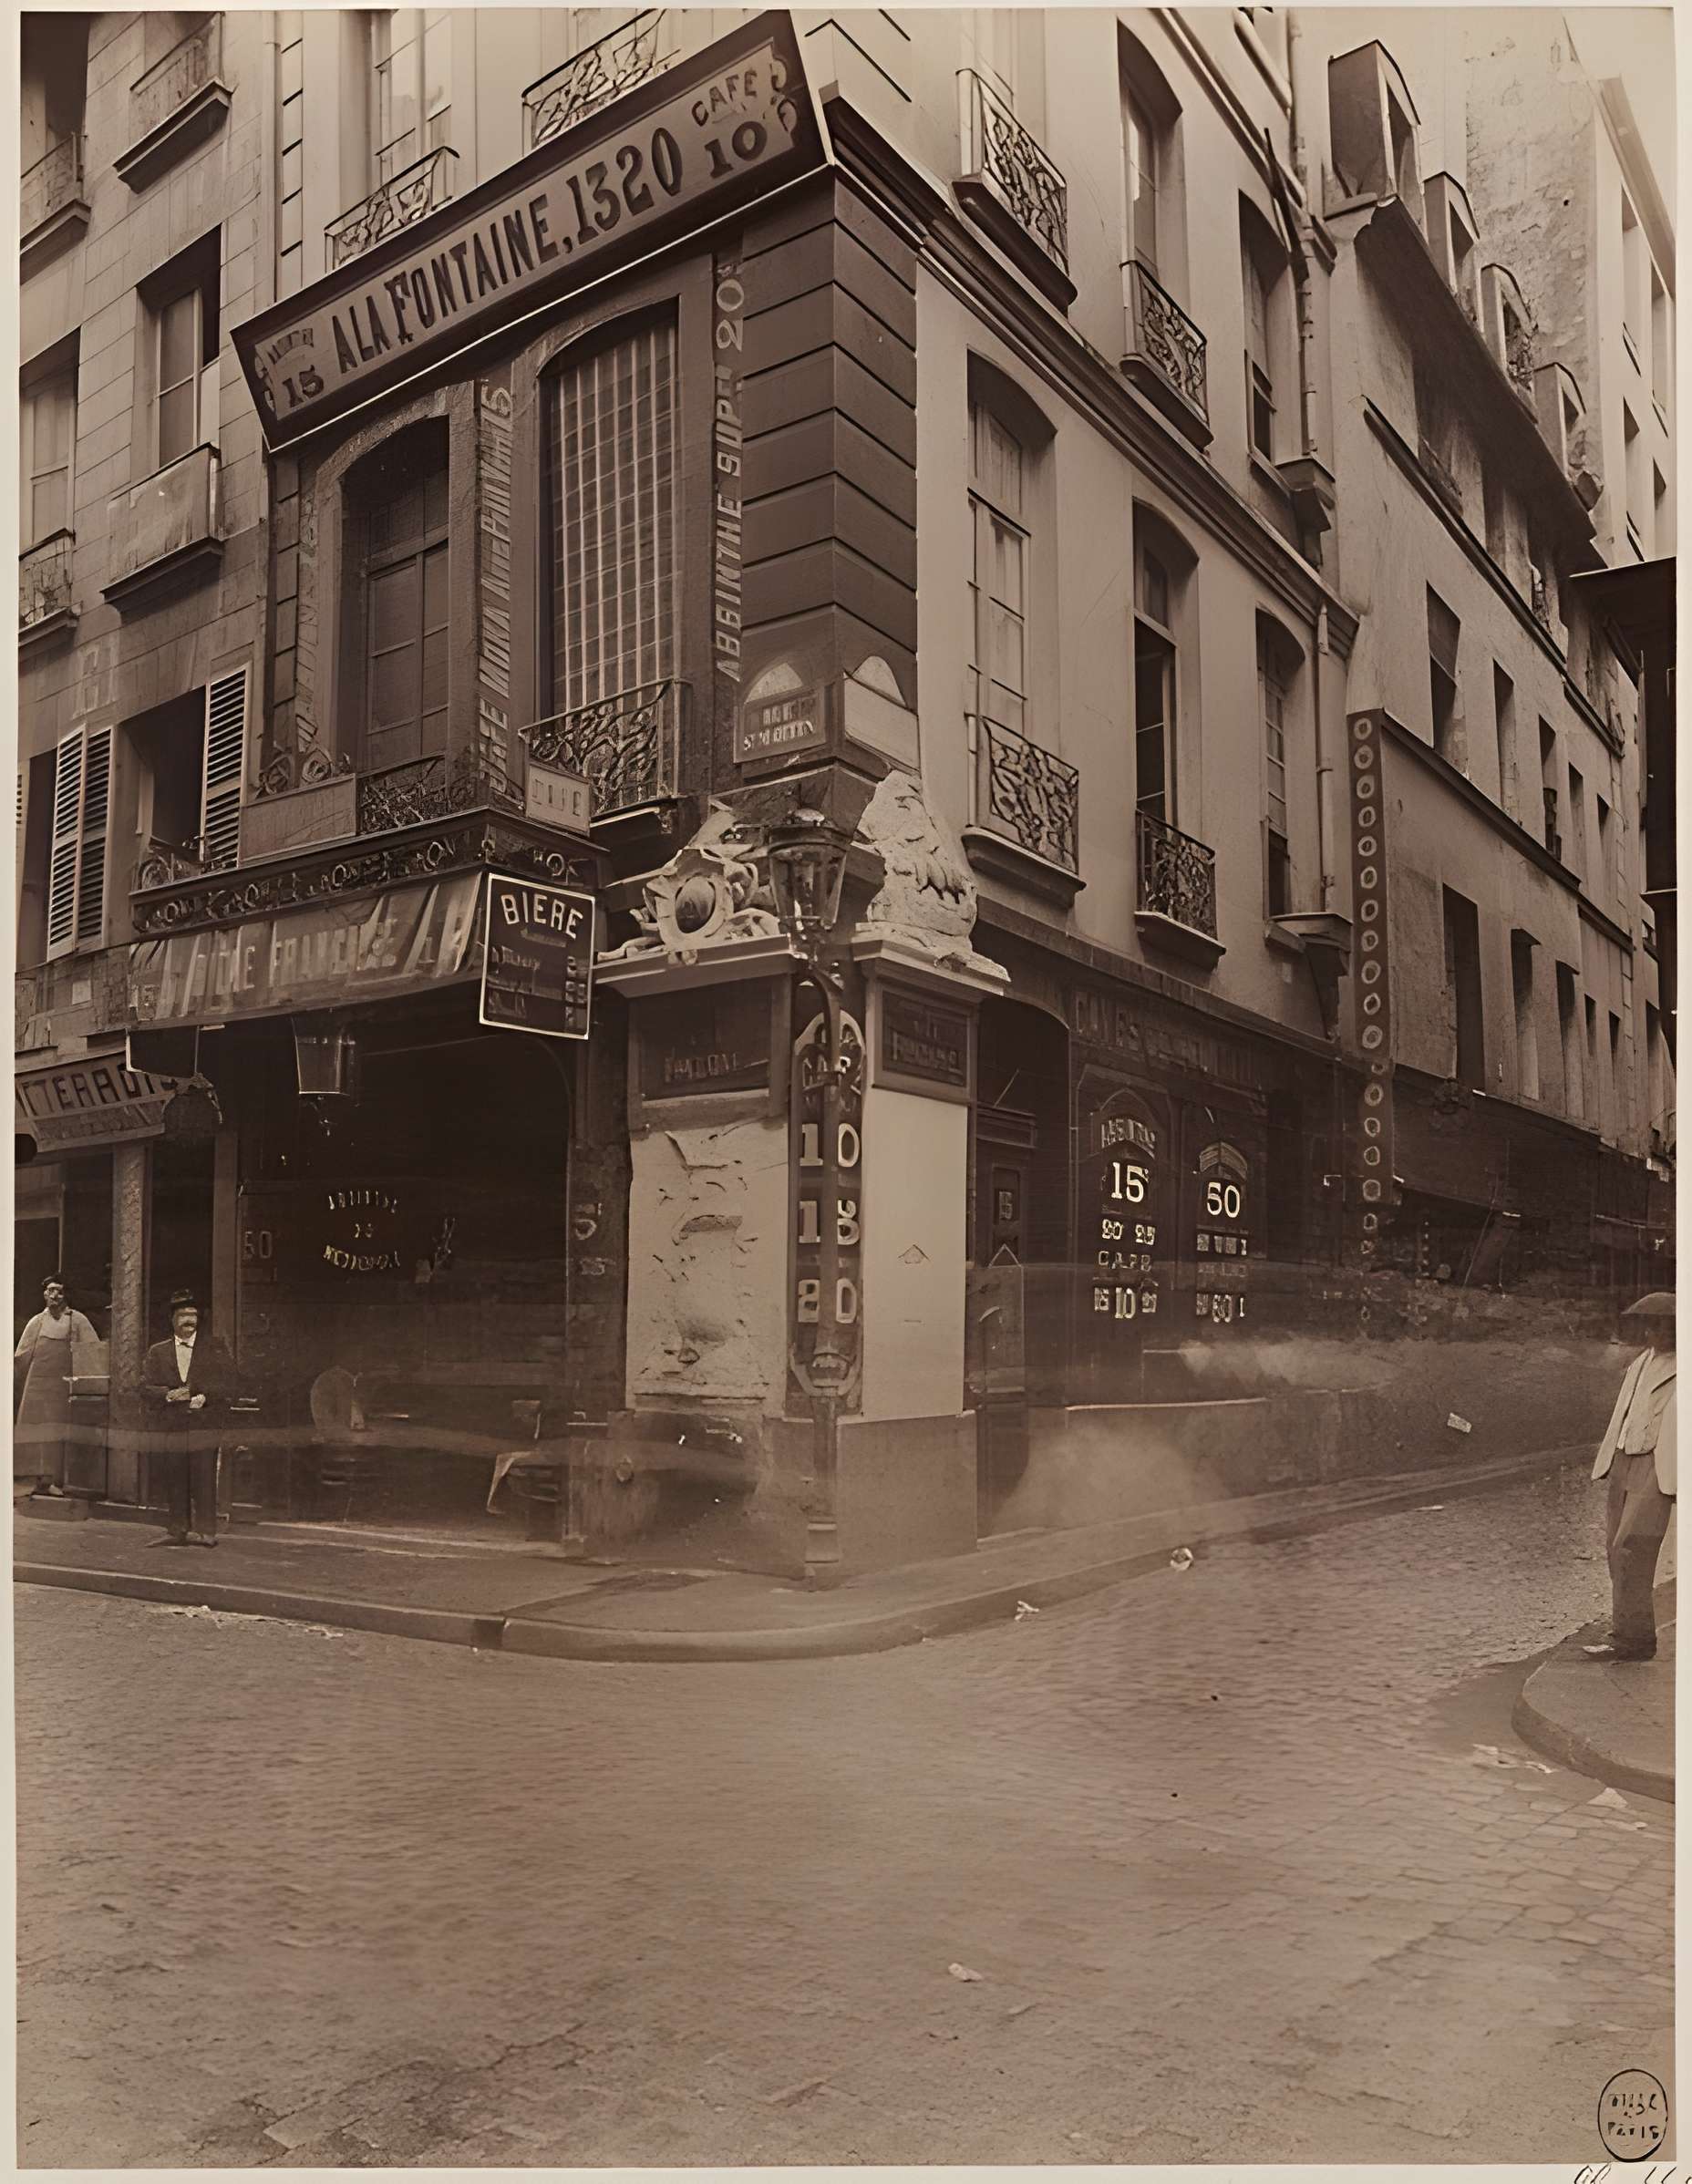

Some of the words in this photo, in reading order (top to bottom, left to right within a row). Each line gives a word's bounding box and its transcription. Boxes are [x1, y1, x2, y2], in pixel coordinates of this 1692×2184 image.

[704, 120, 769, 179] 10
[500, 891, 584, 940] BIERE
[1110, 1161, 1146, 1203] 15
[1206, 1181, 1241, 1218] 50
